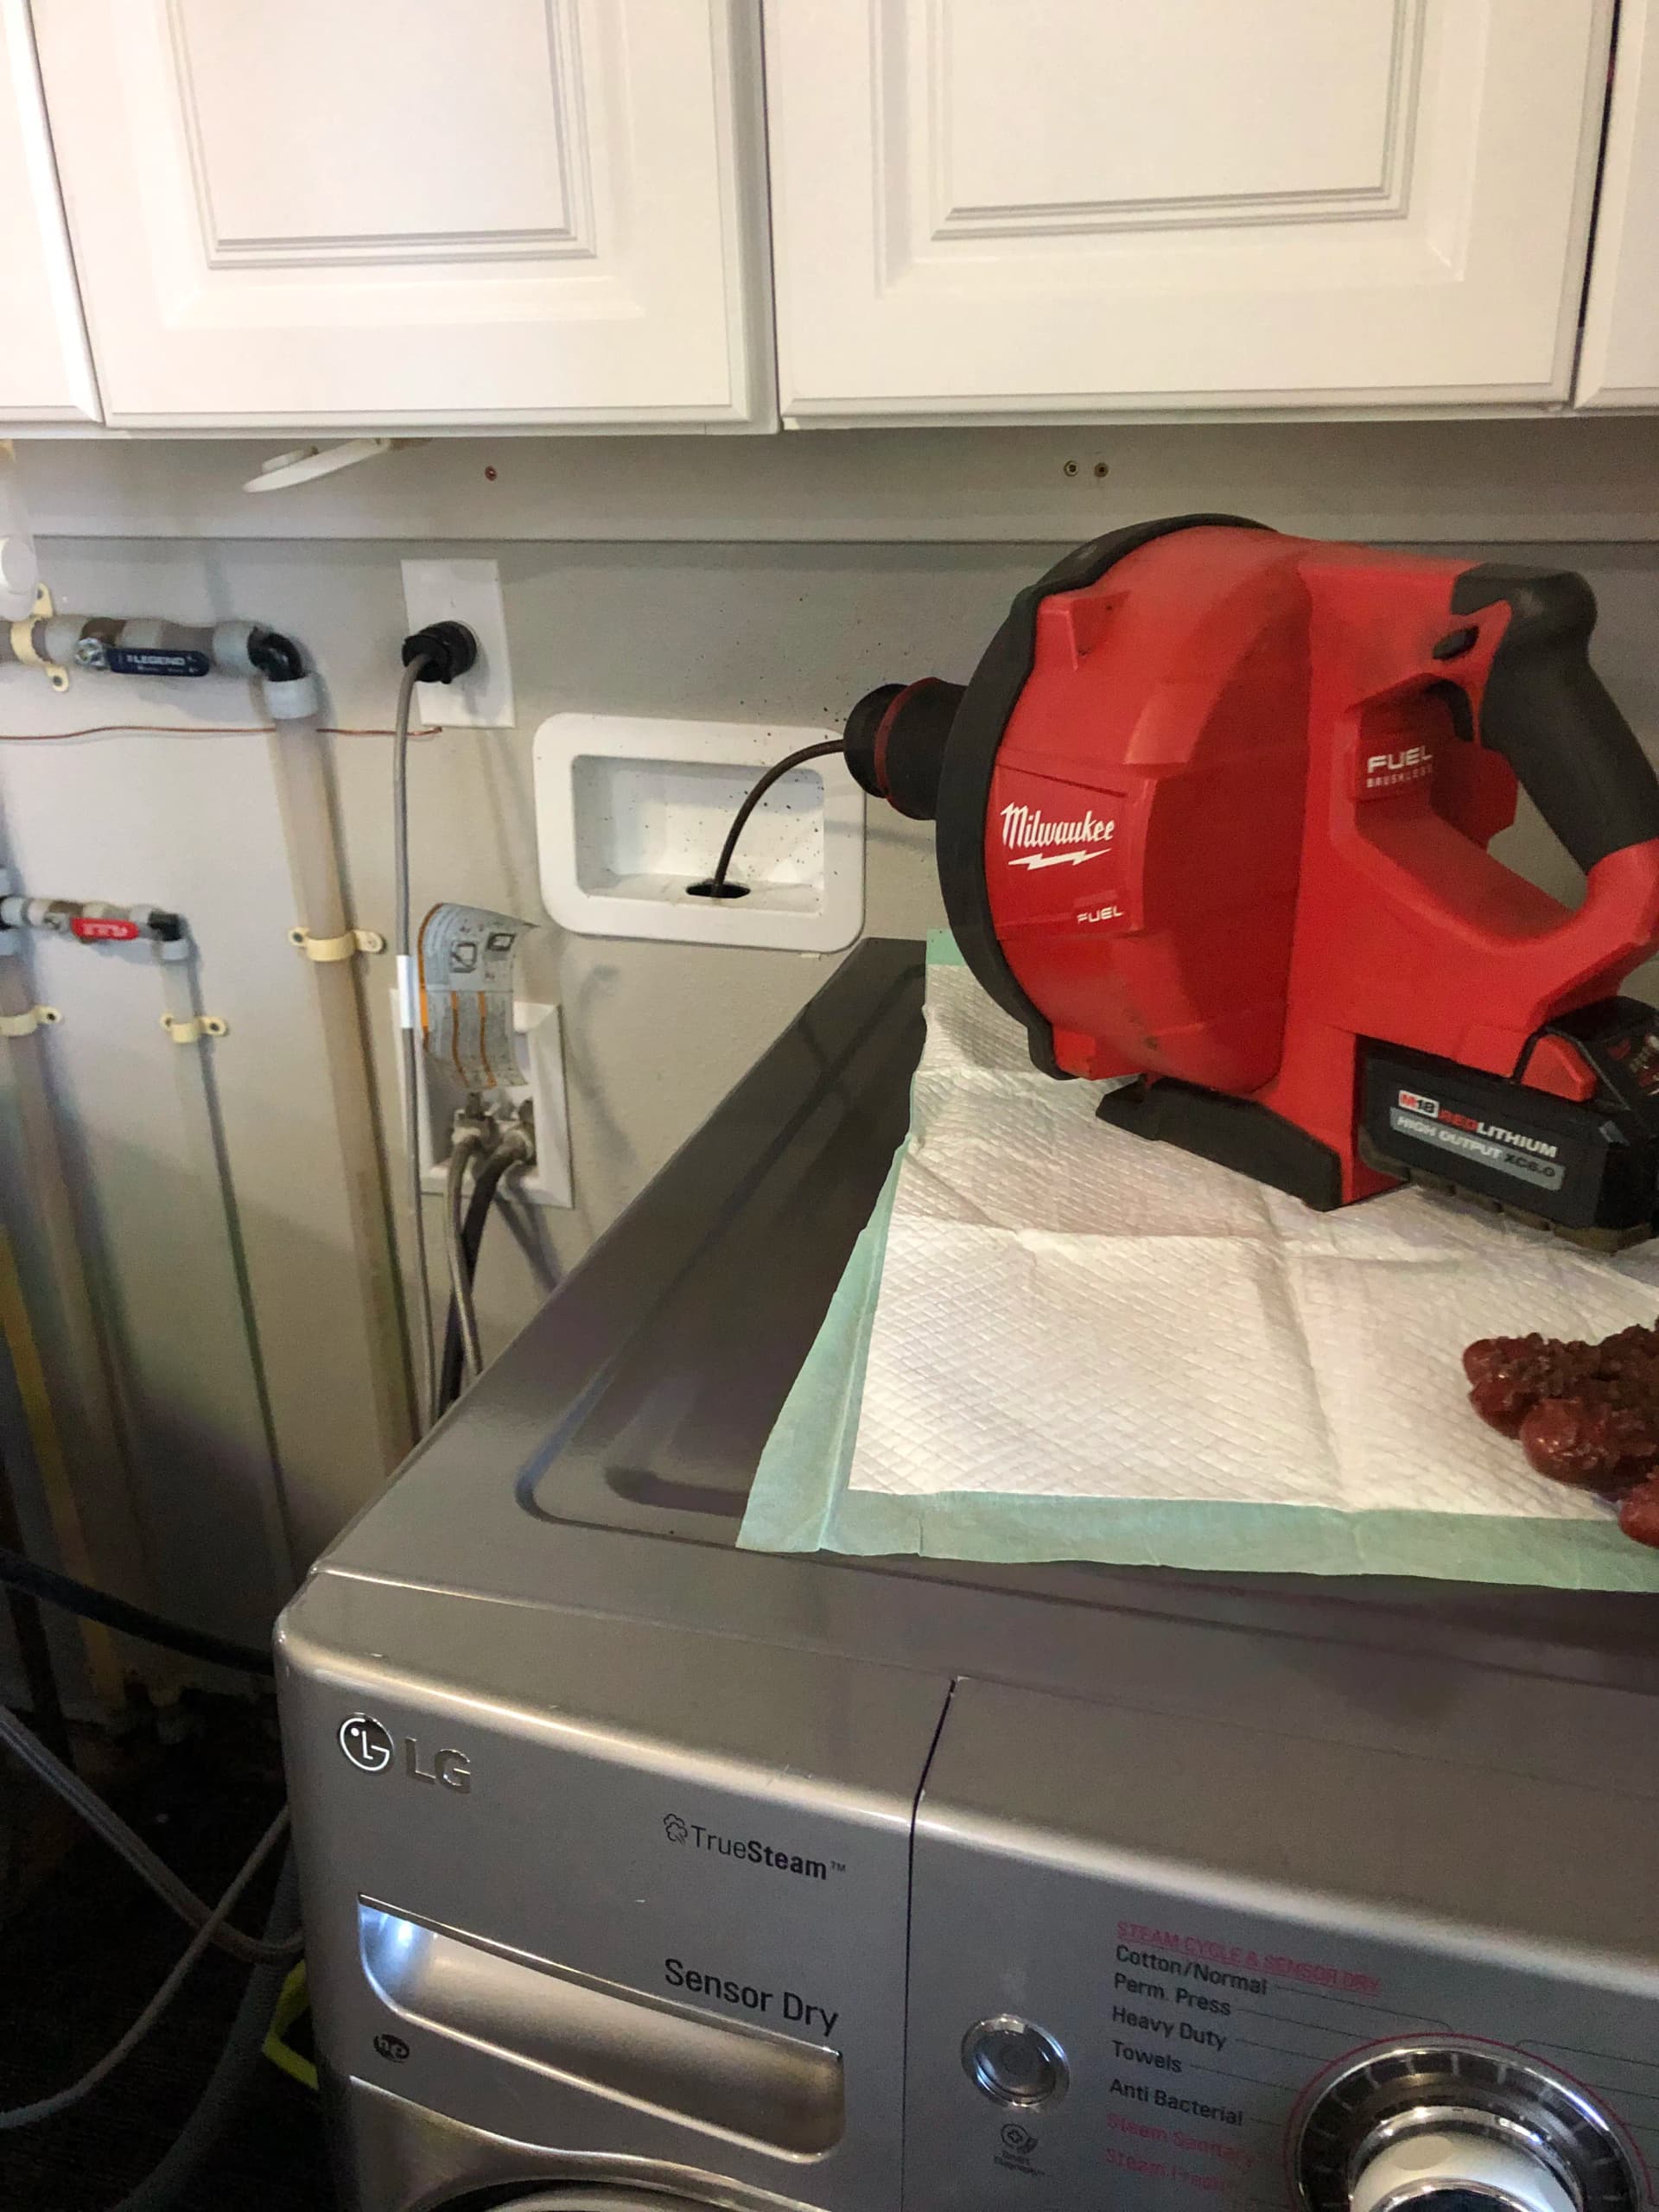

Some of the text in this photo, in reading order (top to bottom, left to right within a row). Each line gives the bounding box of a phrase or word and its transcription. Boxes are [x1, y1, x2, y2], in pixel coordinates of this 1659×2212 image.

[1367, 746, 1433, 773] FUEL
[1000, 801, 1115, 849] Milwaukee
[1077, 906, 1123, 924] FUEL
[1396, 1116, 1436, 1136] HIGH
[1438, 1130, 1503, 1159] OUTPUT
[404, 1736, 472, 1794] LG
[1116, 1944, 1268, 1995] Cotton/Normal
[664, 1957, 839, 2037] Sensor Dry
[1176, 1987, 1231, 2017] Press
[1112, 2005, 1228, 2052] Heavy Duty
[1112, 2038, 1183, 2074] Towels
[1109, 2078, 1244, 2126] Anti Bacterial
